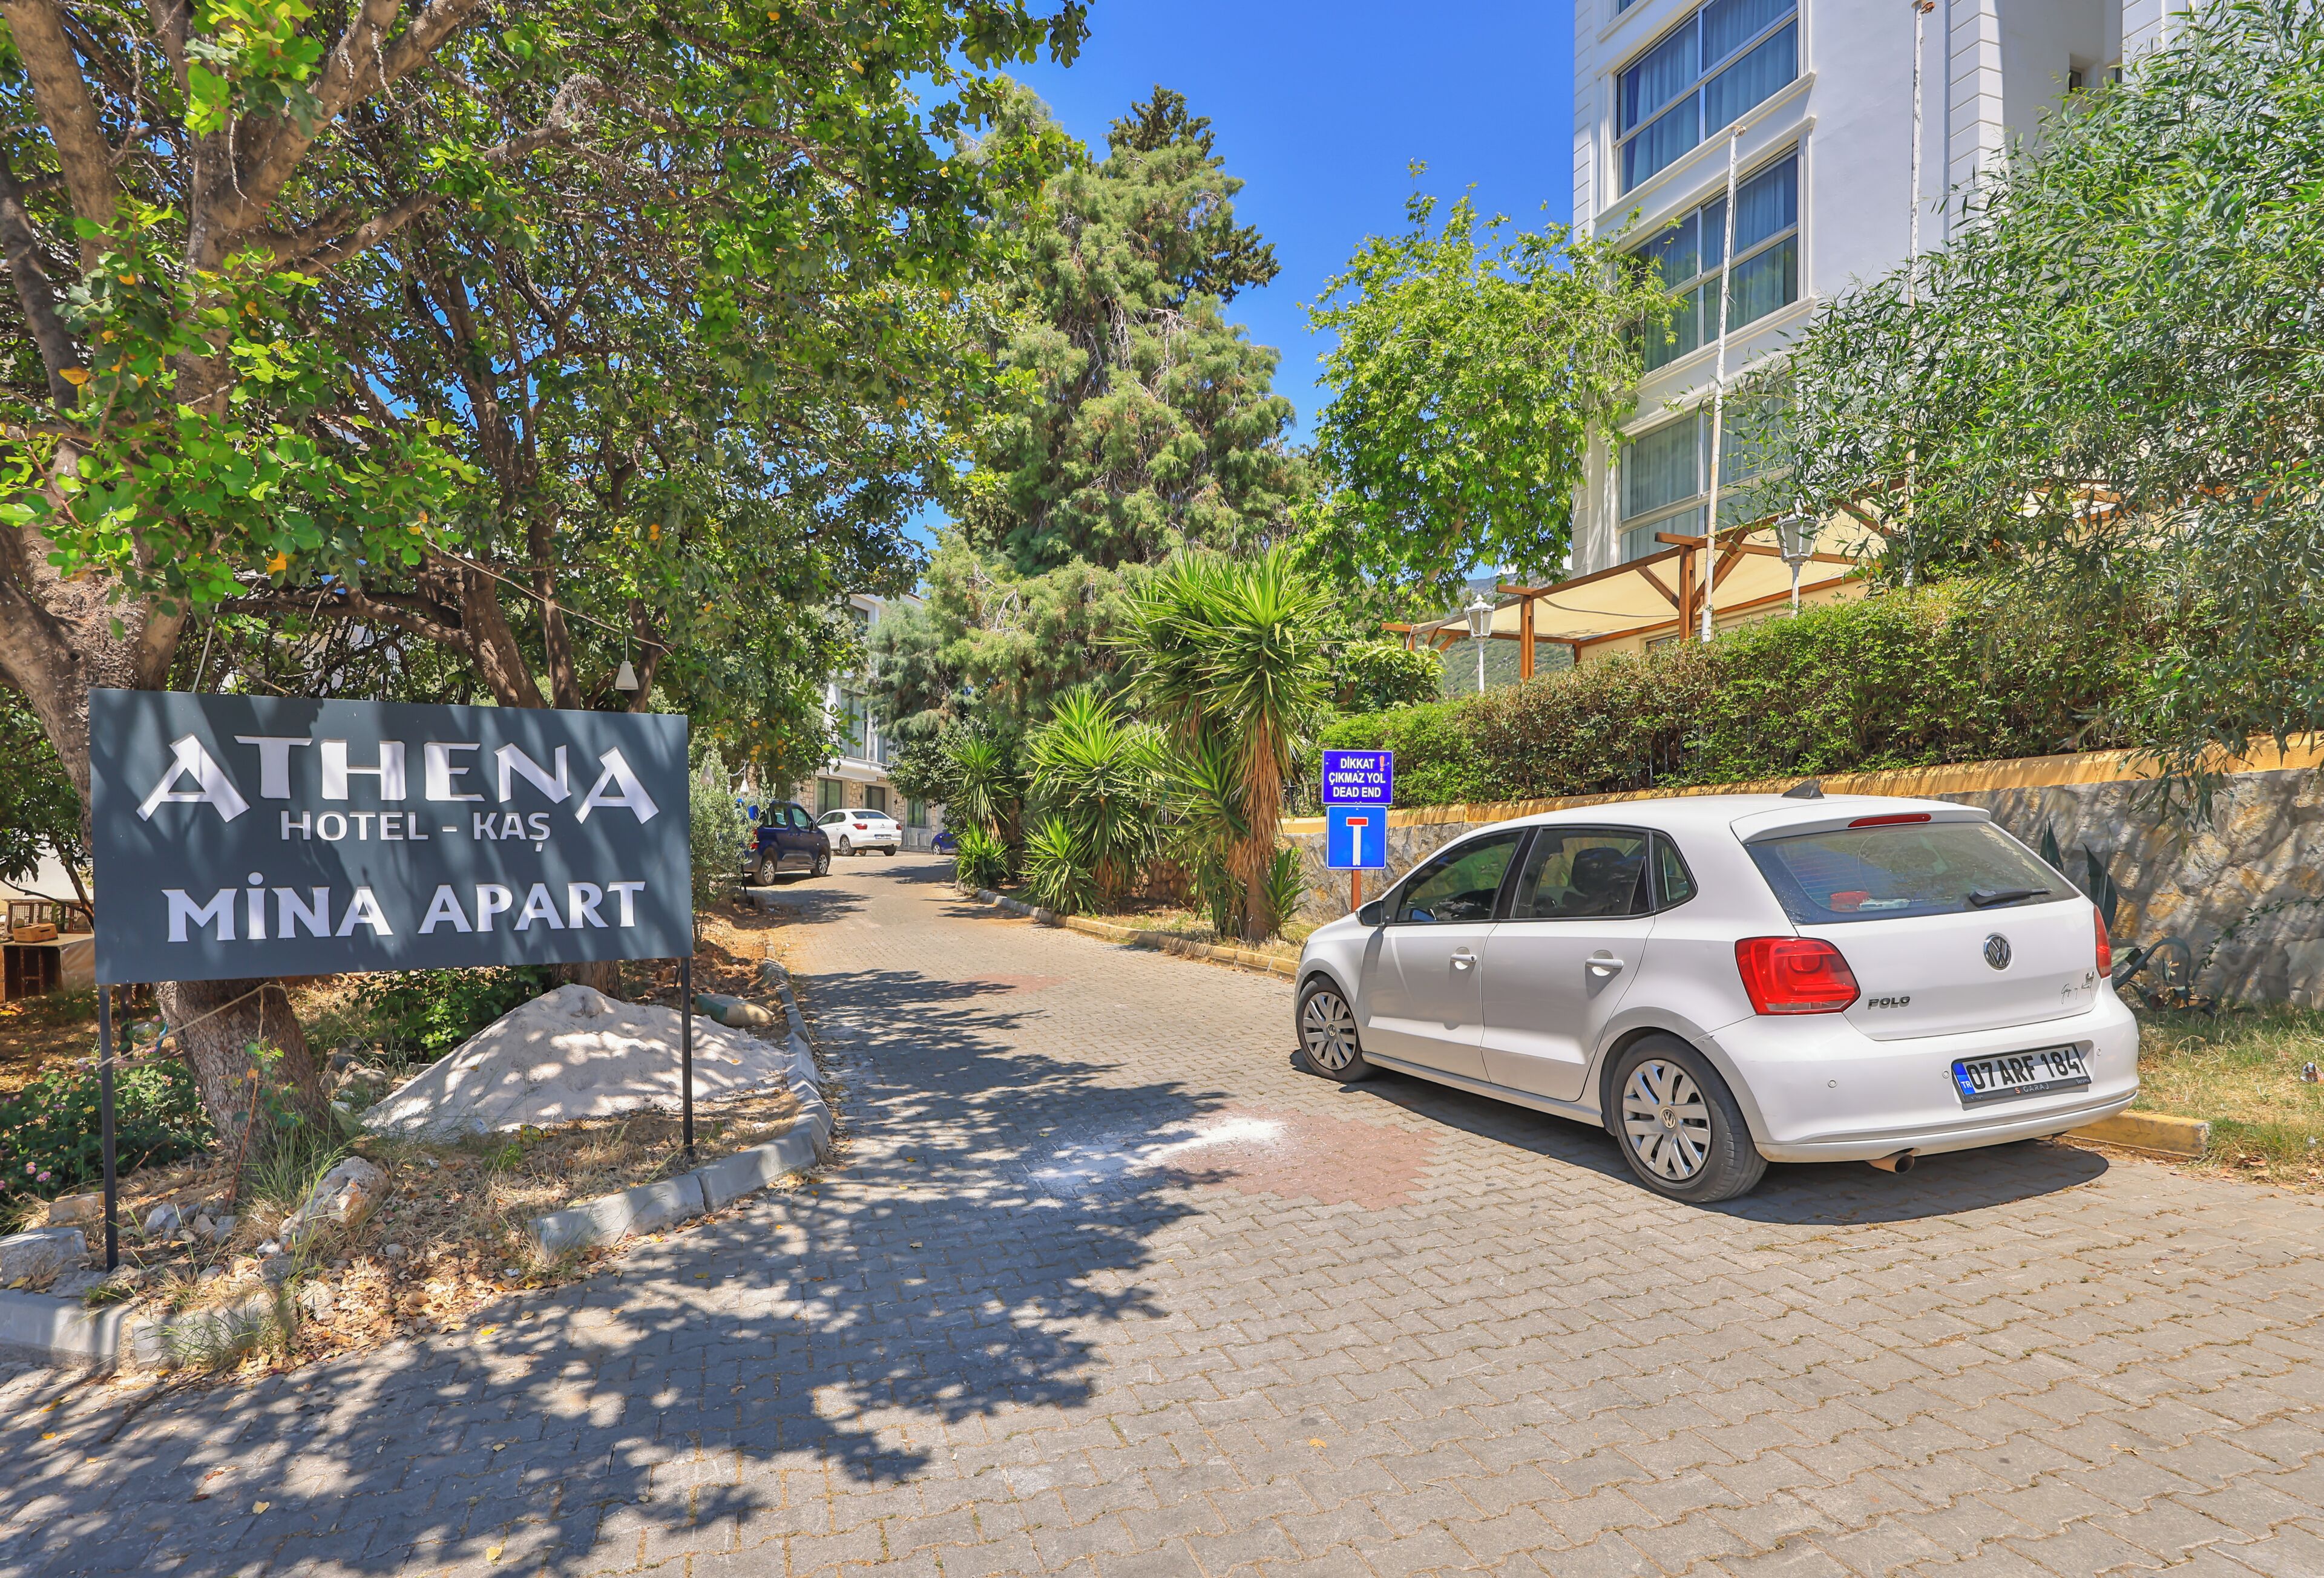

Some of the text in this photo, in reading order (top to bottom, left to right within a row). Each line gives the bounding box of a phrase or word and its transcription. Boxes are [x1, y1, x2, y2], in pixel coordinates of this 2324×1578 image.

[1340, 756, 1374, 769] DİKKAT
[136, 732, 660, 824] ATHENA
[1328, 772, 1386, 785] ÇIKMAZ YOL
[1333, 787, 1381, 797] DEAD END
[280, 810, 428, 841] HOTEL
[473, 811, 551, 852] KAŞ
[161, 871, 646, 942] MİNA APART
[1868, 996, 1911, 1008] POLO
[1966, 1062, 1996, 1090] 07
[1997, 1055, 2035, 1085] ARF
[2040, 1049, 2081, 1078] 184
